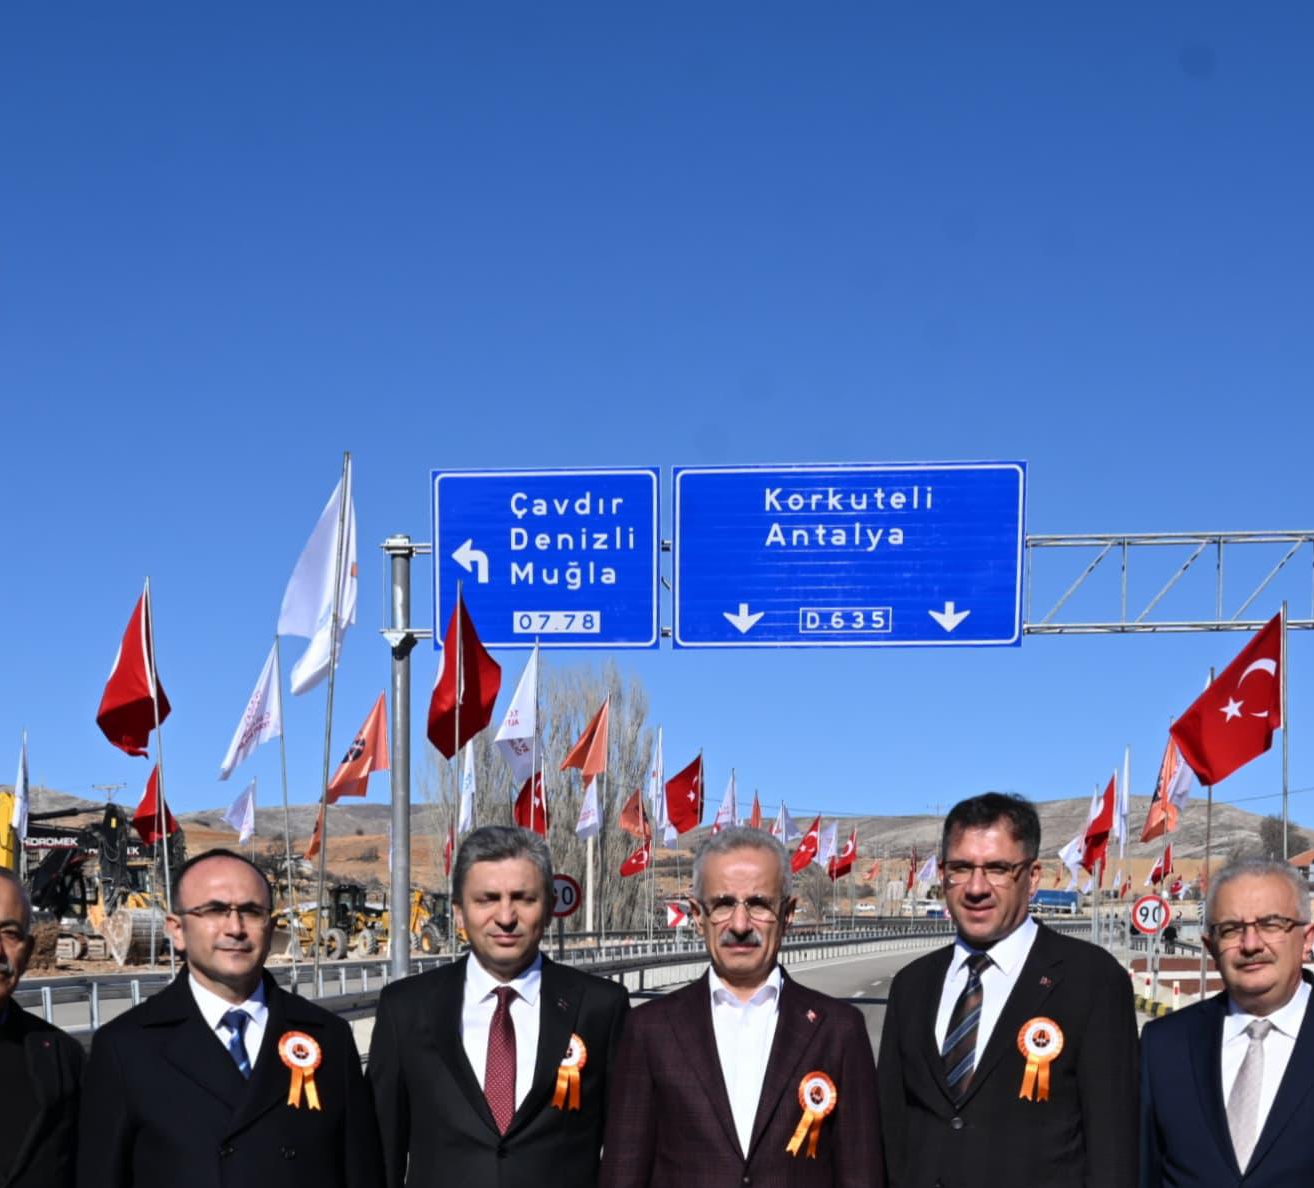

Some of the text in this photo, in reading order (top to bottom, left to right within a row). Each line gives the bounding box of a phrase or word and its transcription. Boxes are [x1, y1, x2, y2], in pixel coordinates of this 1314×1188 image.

[511, 492, 623, 519] Çavdır
[765, 486, 932, 511] Korkuteli
[511, 526, 634, 550] Denizli
[765, 522, 904, 551] Antalya
[511, 561, 616, 590] Muğla
[519, 614, 594, 630] 07.78
[806, 611, 885, 629] D.635
